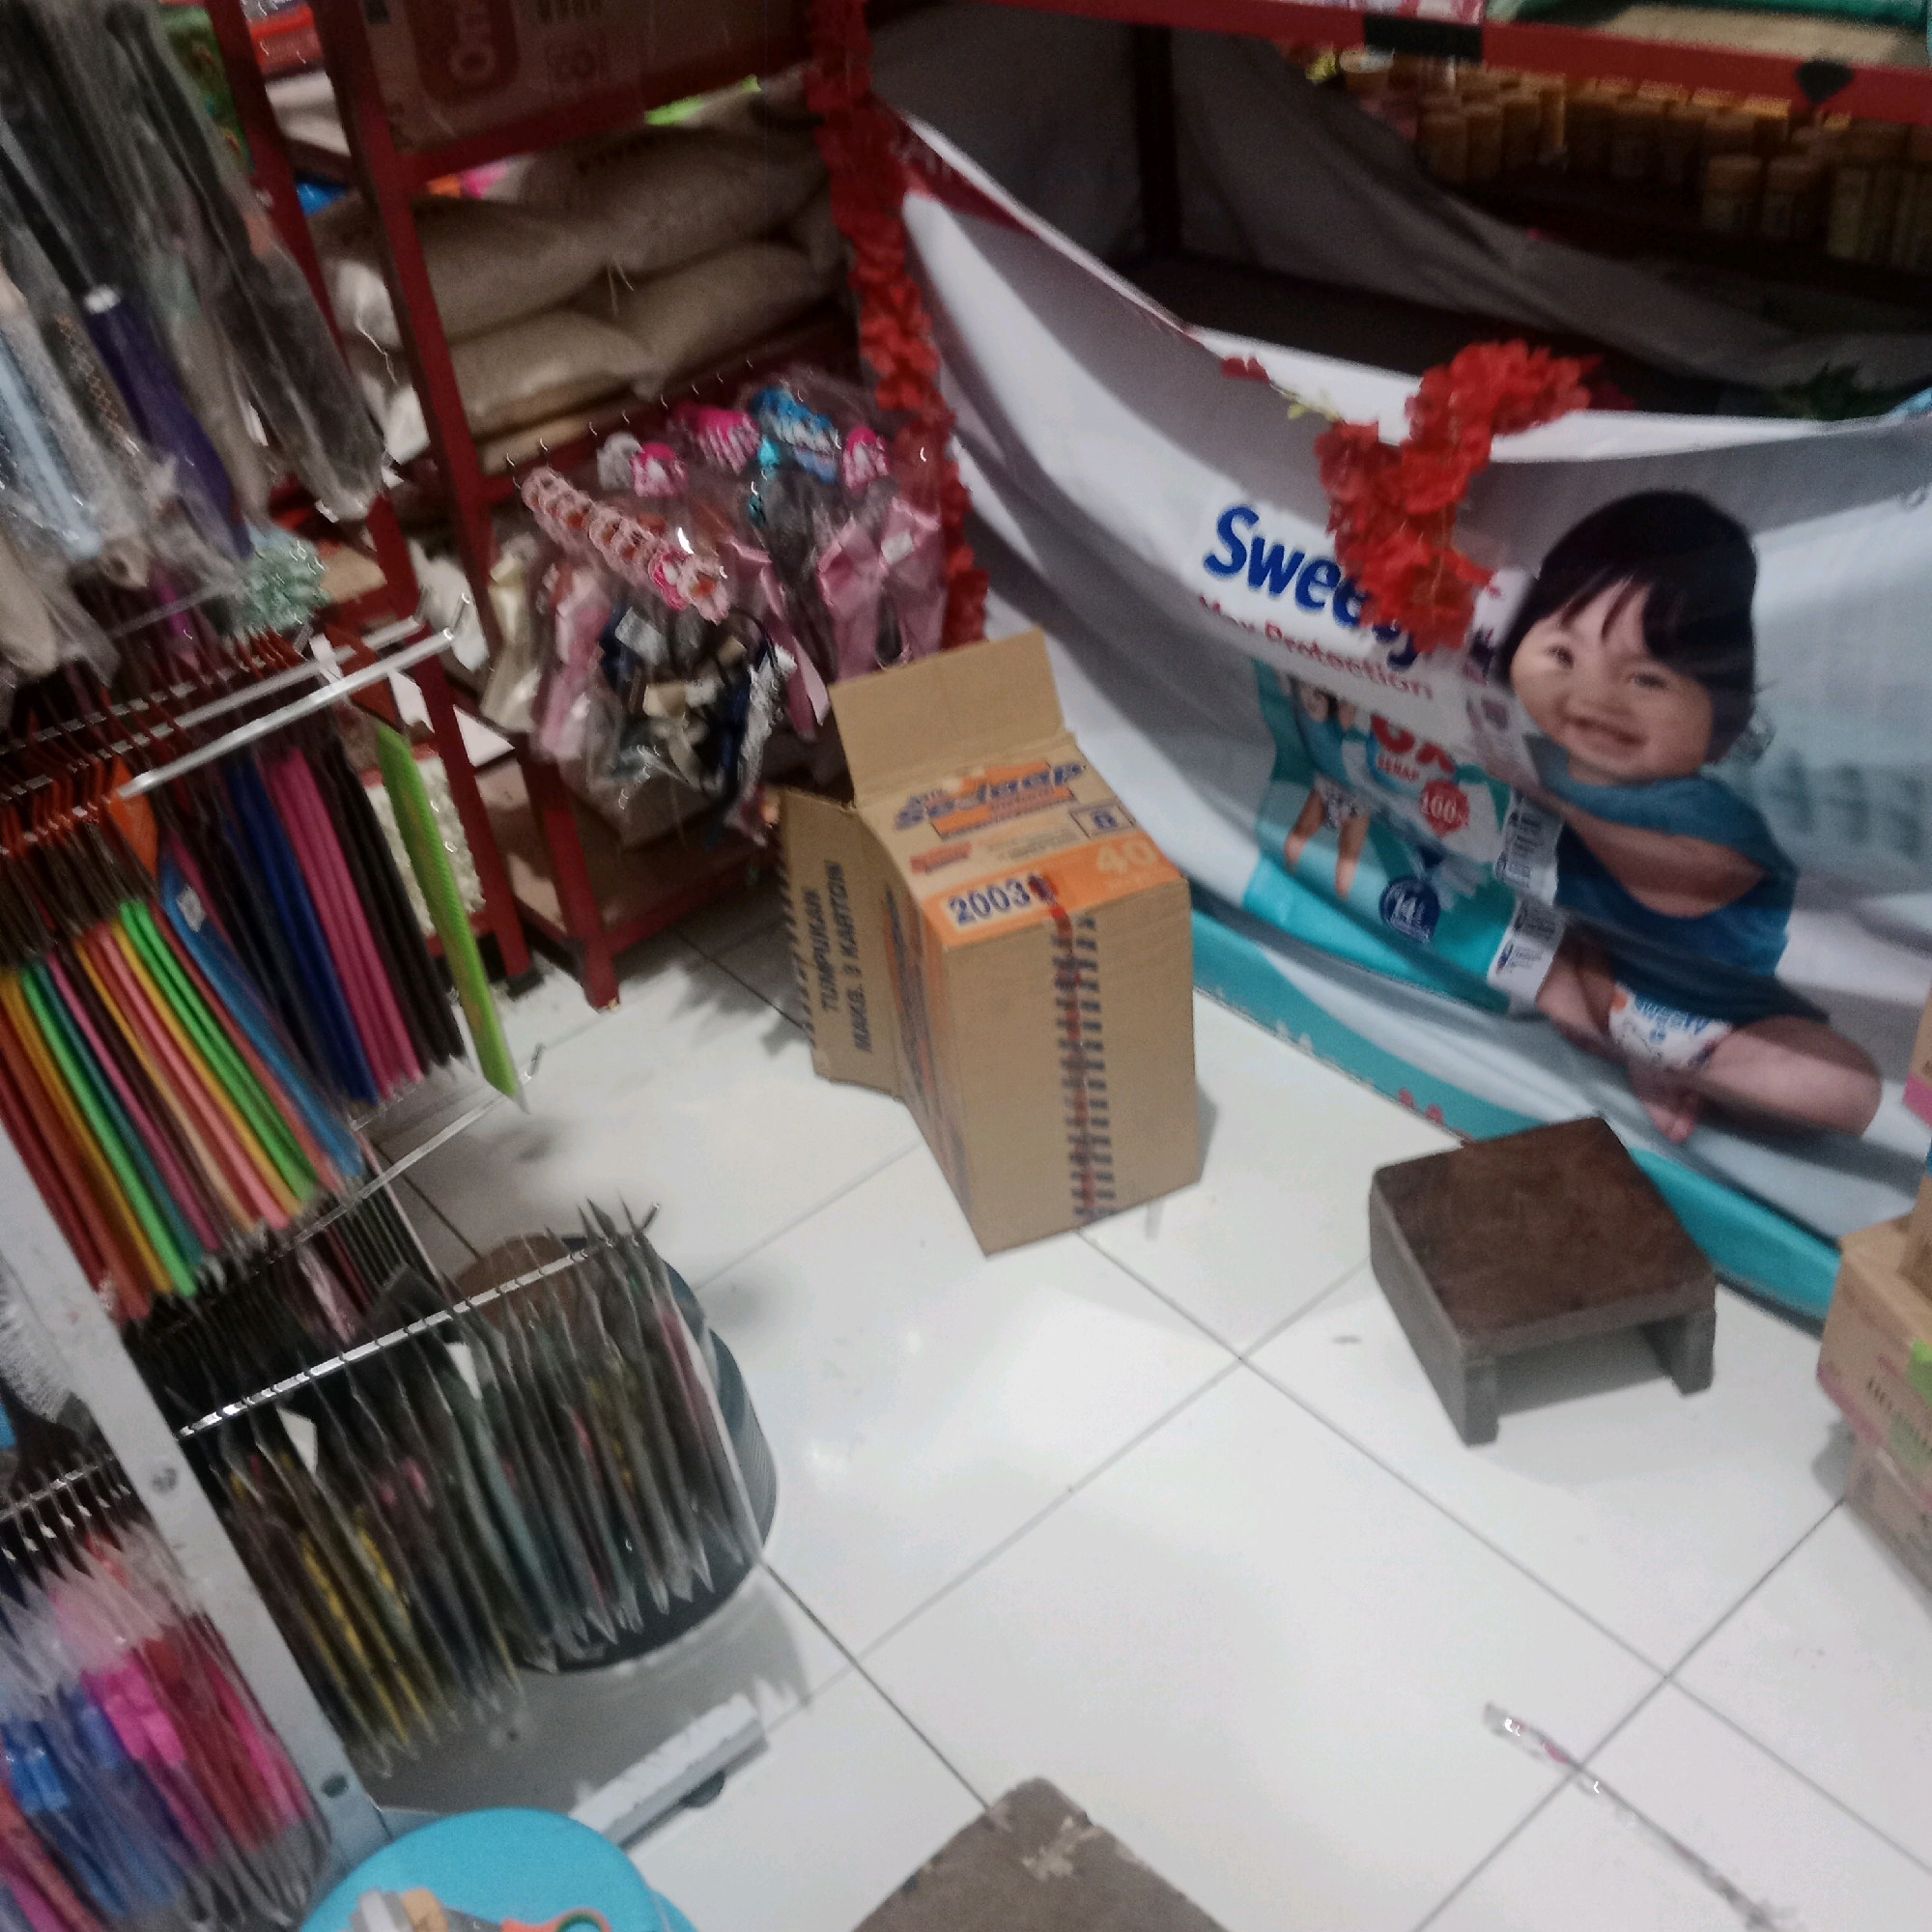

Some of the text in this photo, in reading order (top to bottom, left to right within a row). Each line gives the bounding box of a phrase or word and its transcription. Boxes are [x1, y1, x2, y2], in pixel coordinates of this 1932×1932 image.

[1203, 503, 1428, 670] Swee
[825, 860, 858, 958] KARTON
[1097, 838, 1157, 873] 40
[803, 887, 838, 1011] TUMPUKAN
